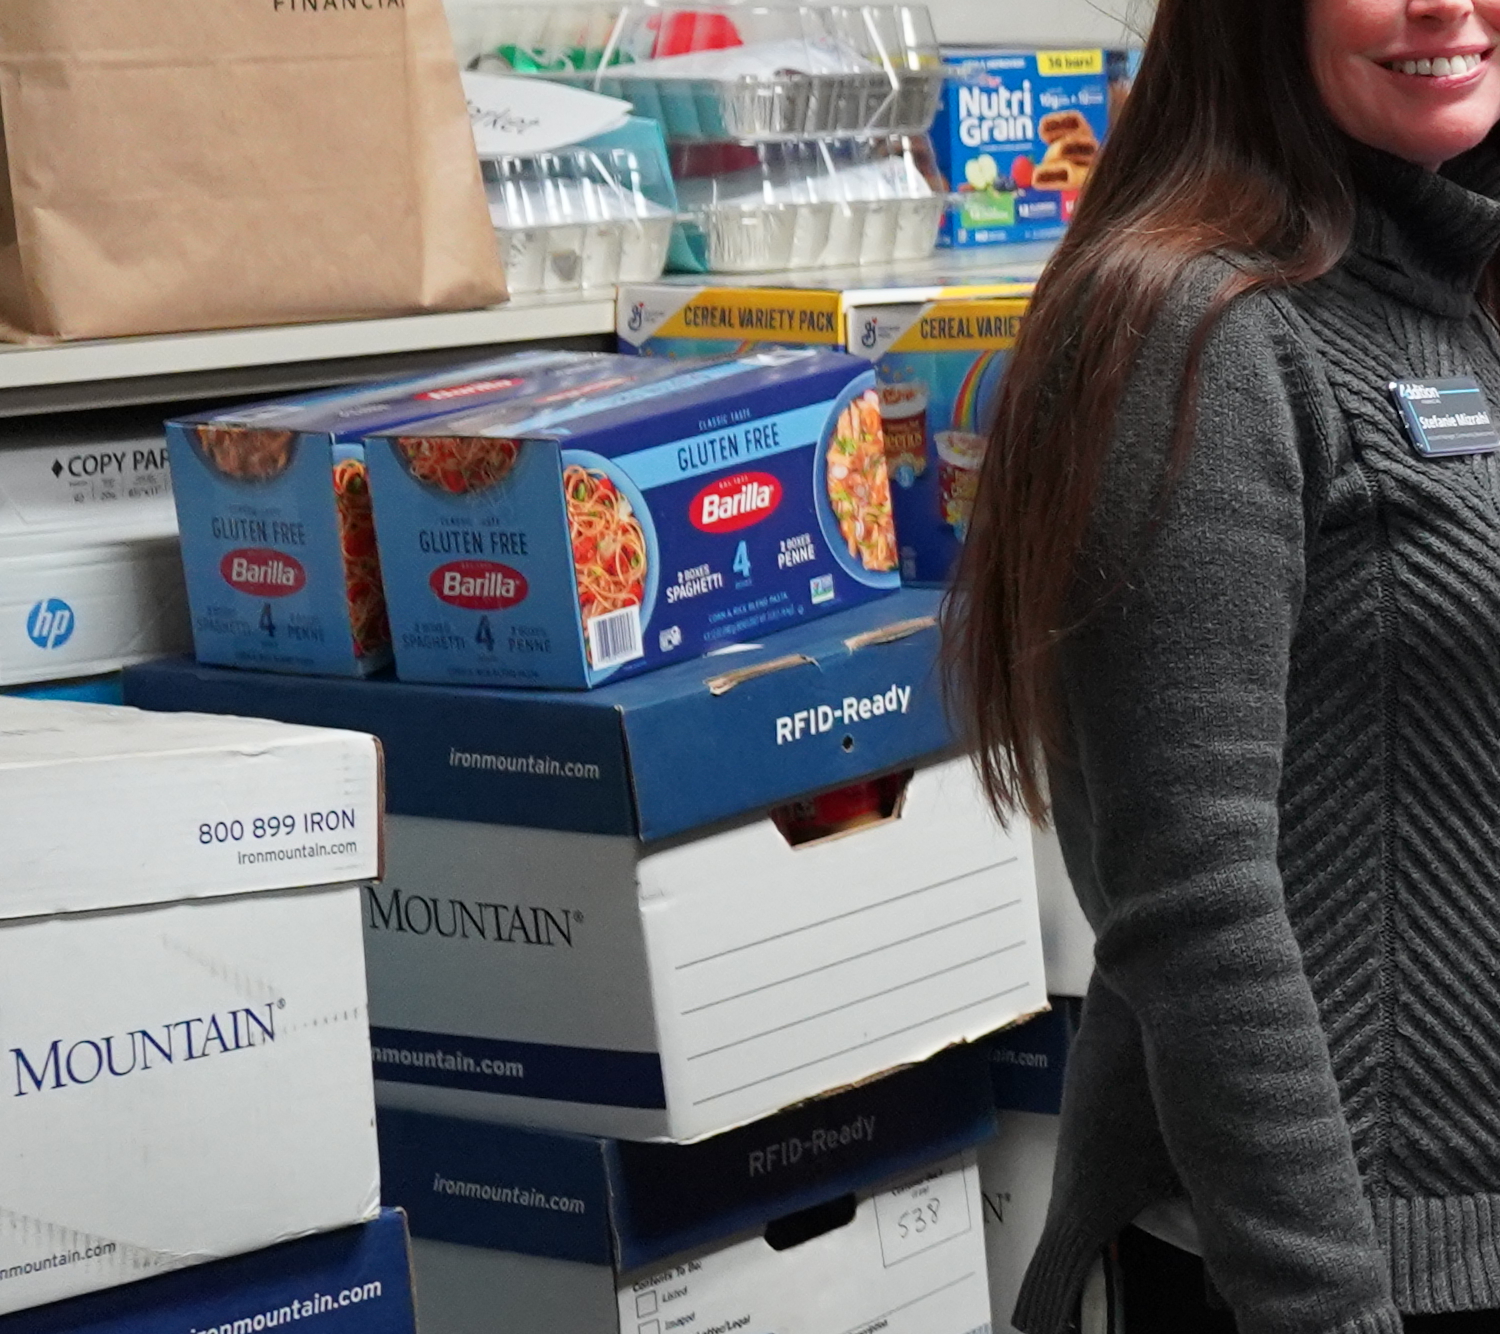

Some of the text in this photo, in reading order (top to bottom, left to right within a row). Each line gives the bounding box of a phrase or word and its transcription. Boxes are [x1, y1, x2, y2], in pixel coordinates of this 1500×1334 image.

[958, 79, 1032, 119] Nutri
[959, 116, 1034, 147] Grain
[683, 306, 834, 333] CEREAL VARIETY PACK
[920, 315, 1021, 339] CEREAL VARIE
[1419, 414, 1457, 429] Stefanie
[677, 422, 781, 471] GLUTEN FREE
[68, 451, 126, 477] COPY
[701, 482, 773, 525] Barilla
[211, 518, 306, 546] GLUTEN FREE
[419, 530, 529, 556] GLUTEN FREE
[231, 557, 297, 586] Barilla
[732, 540, 751, 579] 4
[777, 545, 816, 569] PENNE
[443, 572, 518, 598] Barilla
[775, 683, 913, 746] RFID-Ready
[449, 748, 600, 780] ironmountain.com
[199, 808, 356, 845] 800 899 IRON
[371, 1045, 524, 1079] nmountain.com
[747, 1114, 877, 1178] RFID-Ready
[433, 1173, 586, 1216] ironmountain.com
[897, 1197, 941, 1239] 538
[0, 1241, 117, 1281] nmountain.com
